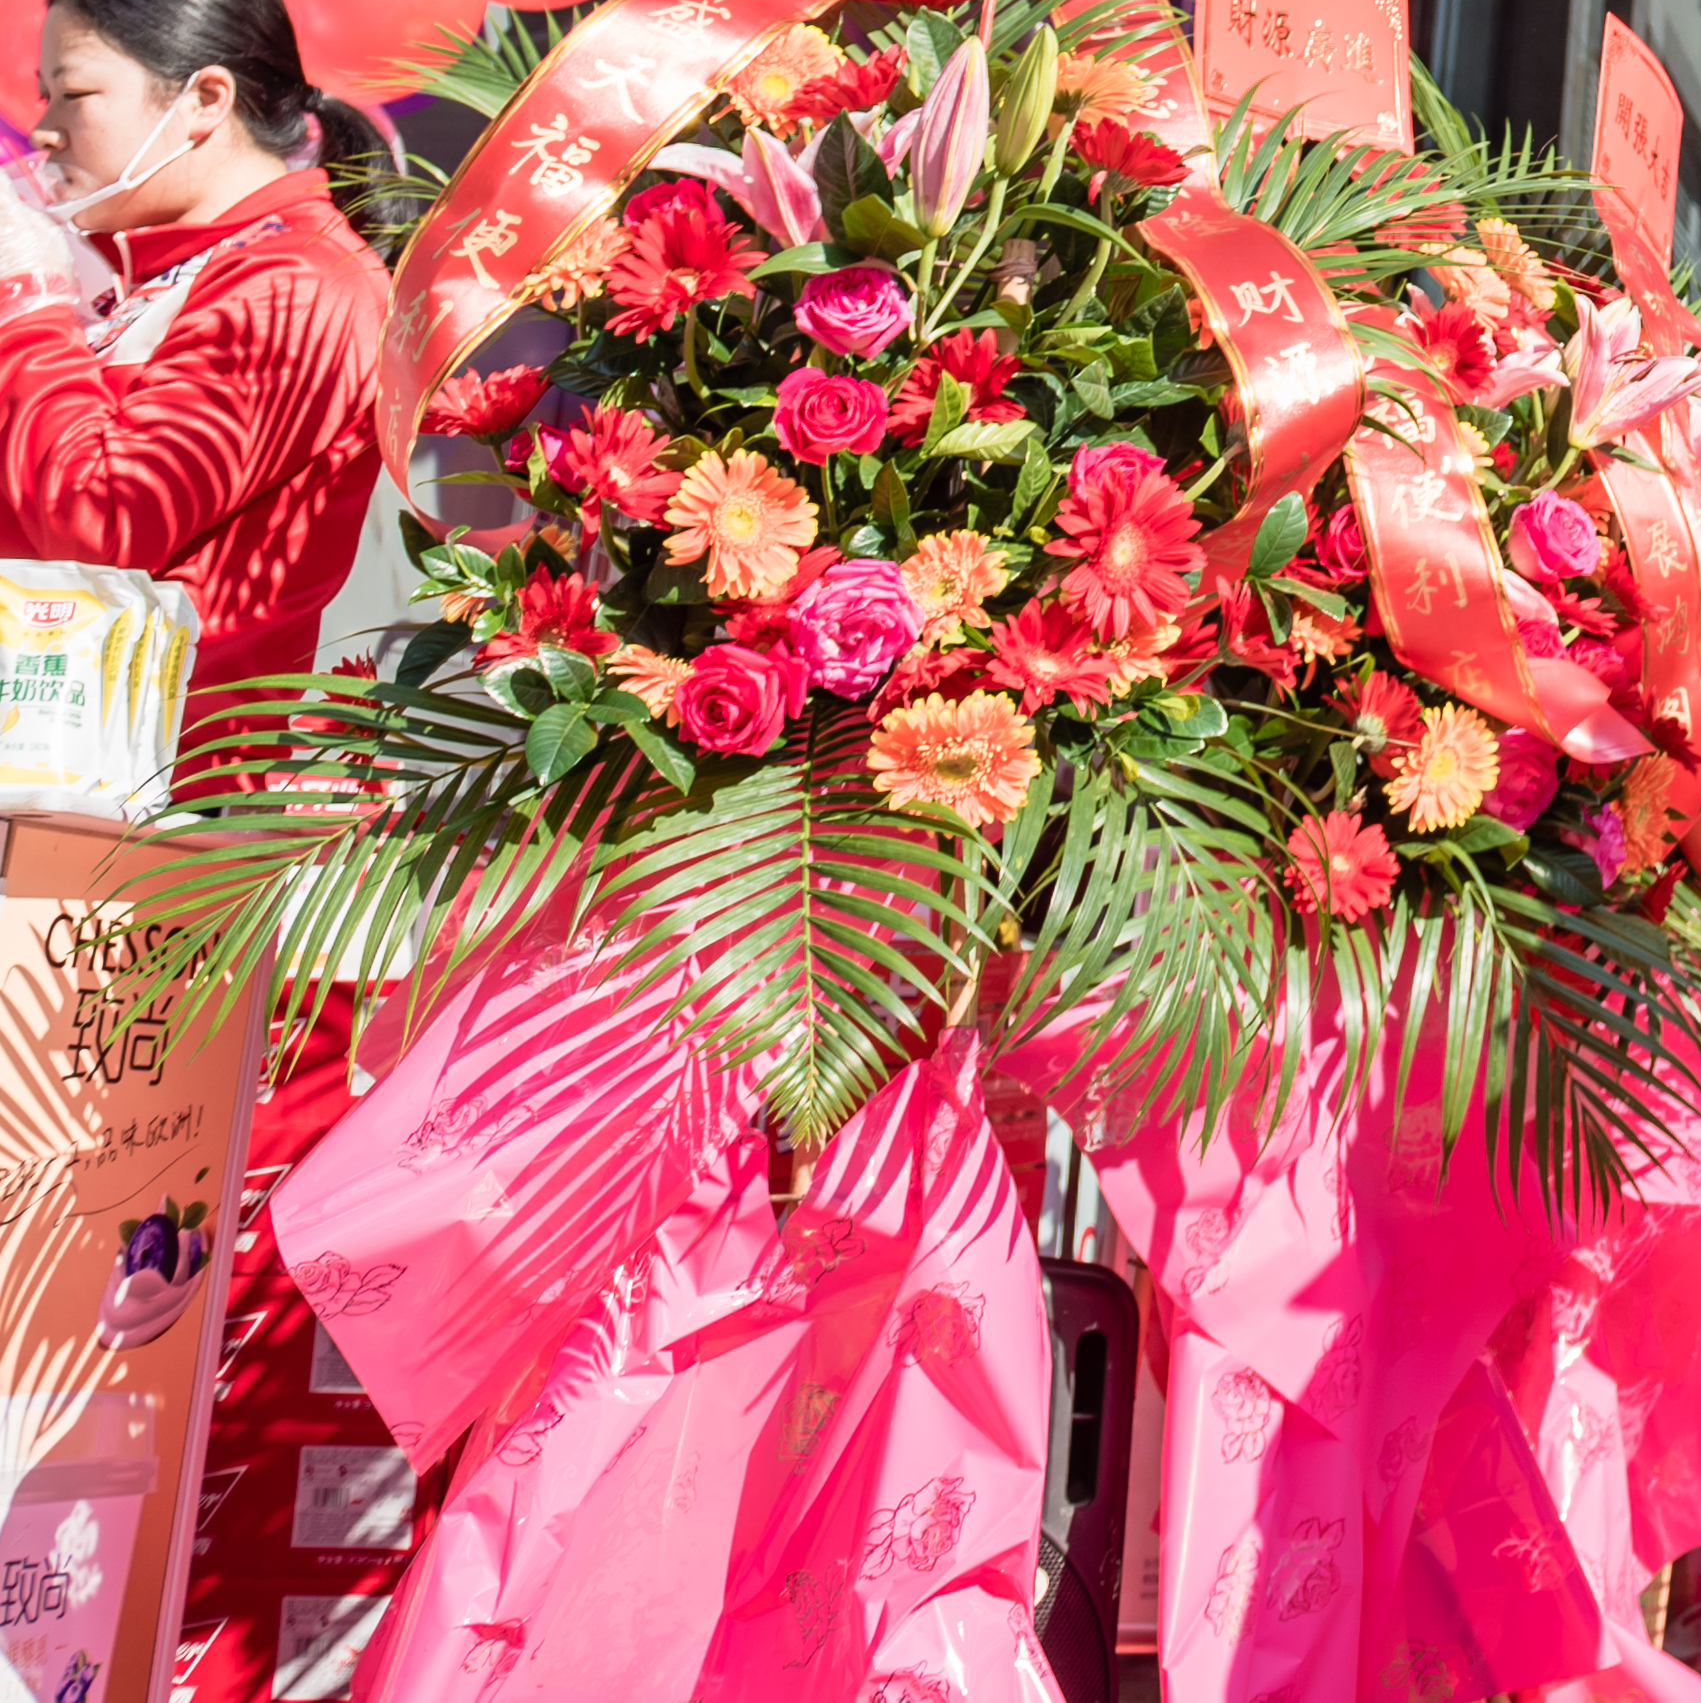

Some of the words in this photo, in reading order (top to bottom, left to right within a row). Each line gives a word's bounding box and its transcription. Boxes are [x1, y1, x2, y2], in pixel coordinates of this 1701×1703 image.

[25, 602, 75, 623] 光明
[14, 653, 68, 677] 香蕉
[61, 988, 174, 1087] 致尚
[0, 1552, 73, 1627] 致尚
